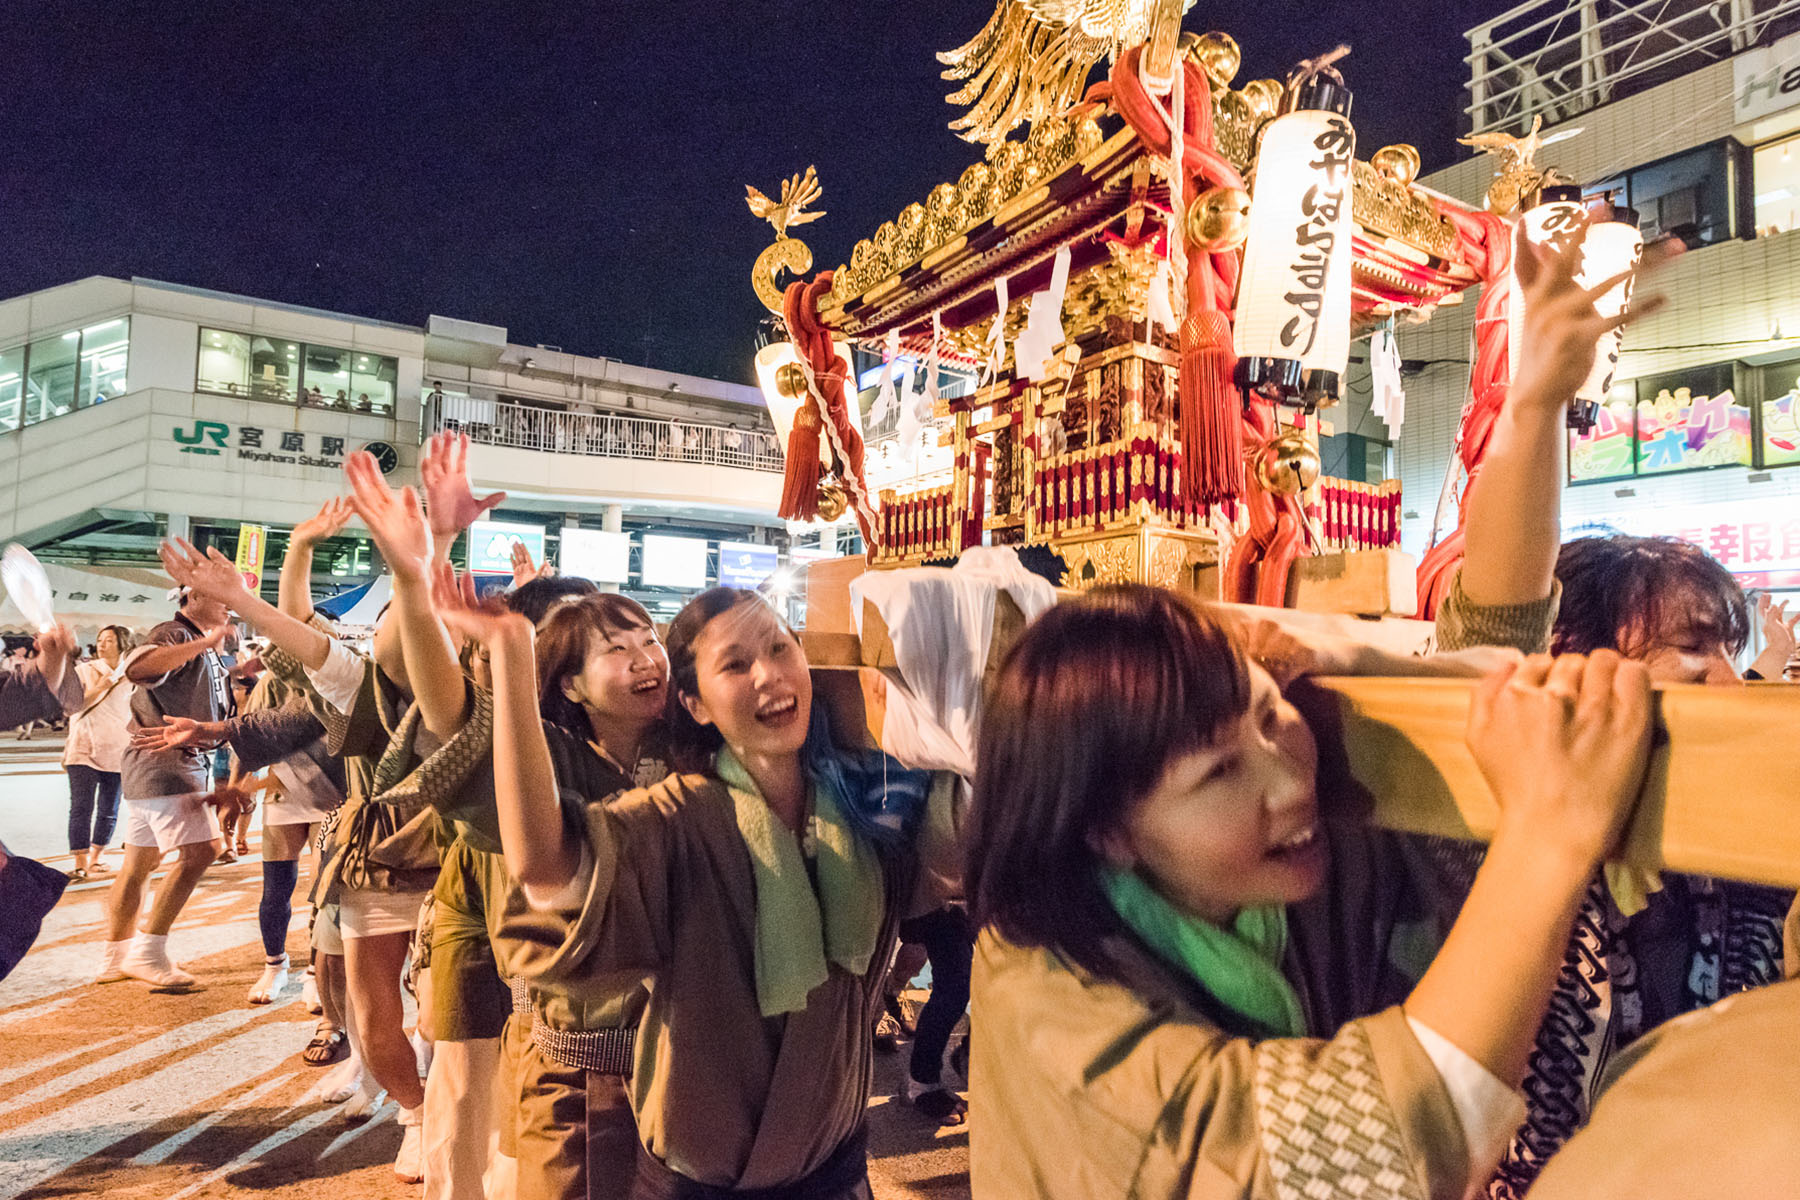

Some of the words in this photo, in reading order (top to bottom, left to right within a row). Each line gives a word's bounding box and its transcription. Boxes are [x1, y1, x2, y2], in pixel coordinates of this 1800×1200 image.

[173, 420, 230, 447] JR
[238, 427, 345, 457] 宮原駅
[238, 449, 296, 465] Miyahara
[298, 455, 344, 469] Station
[52, 589, 152, 603] 自治会
